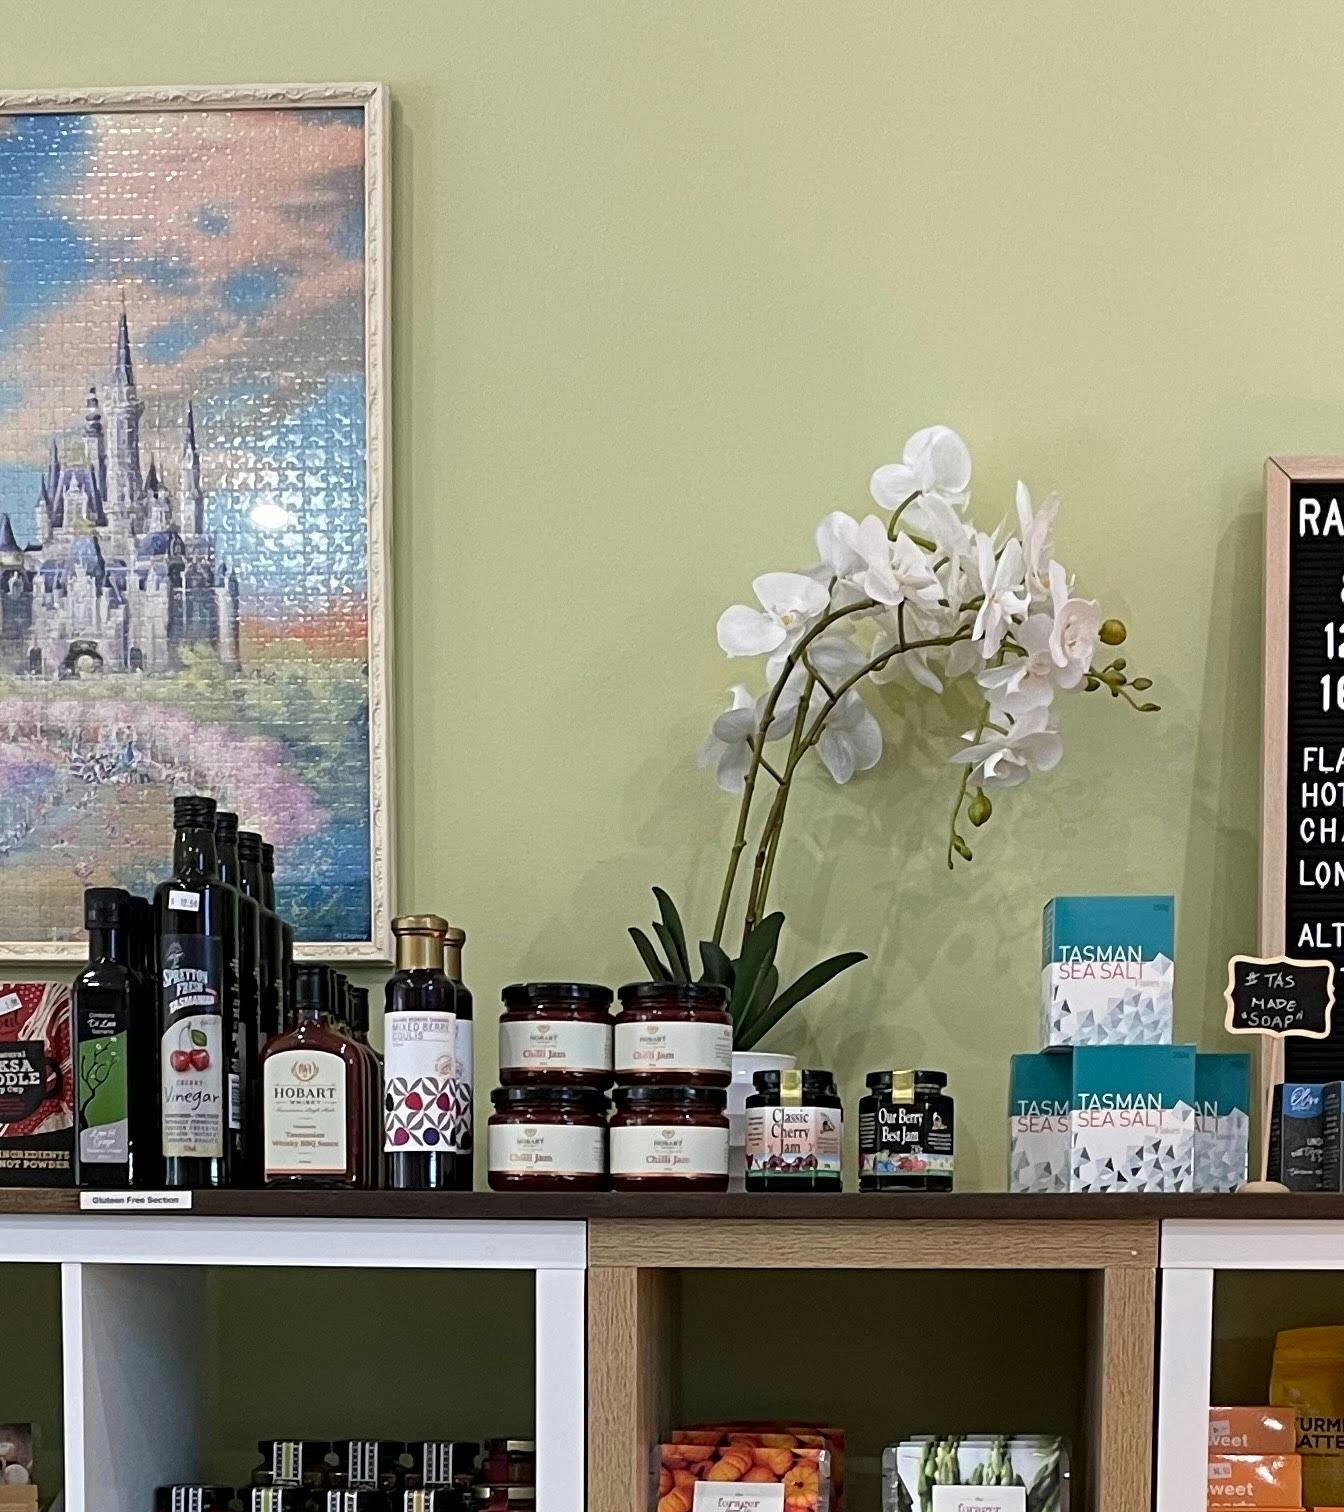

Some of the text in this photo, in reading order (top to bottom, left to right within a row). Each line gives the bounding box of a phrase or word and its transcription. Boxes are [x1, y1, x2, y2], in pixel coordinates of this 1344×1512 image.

[1059, 946, 1142, 962] TASMAN
[1059, 963, 1146, 979] SEA SALT
[1264, 972, 1296, 989] TAS
[1251, 998, 1296, 1011] MADE
[165, 1086, 219, 1110] Vinegar
[274, 1088, 336, 1098] HOBART
[1018, 1101, 1068, 1116] TASM
[1078, 1094, 1162, 1110] TASMAN
[773, 1109, 809, 1123] Classic
[878, 1108, 923, 1125] Our Berry
[1078, 1111, 1114, 1127] SEA
[1120, 1111, 1166, 1127] SALT
[771, 1124, 809, 1141] Cherry
[1018, 1117, 1053, 1132] SEA
[882, 1126, 918, 1144] Best Jam
[780, 1142, 800, 1155] Jam
[23, 1160, 70, 1169] POWDER
